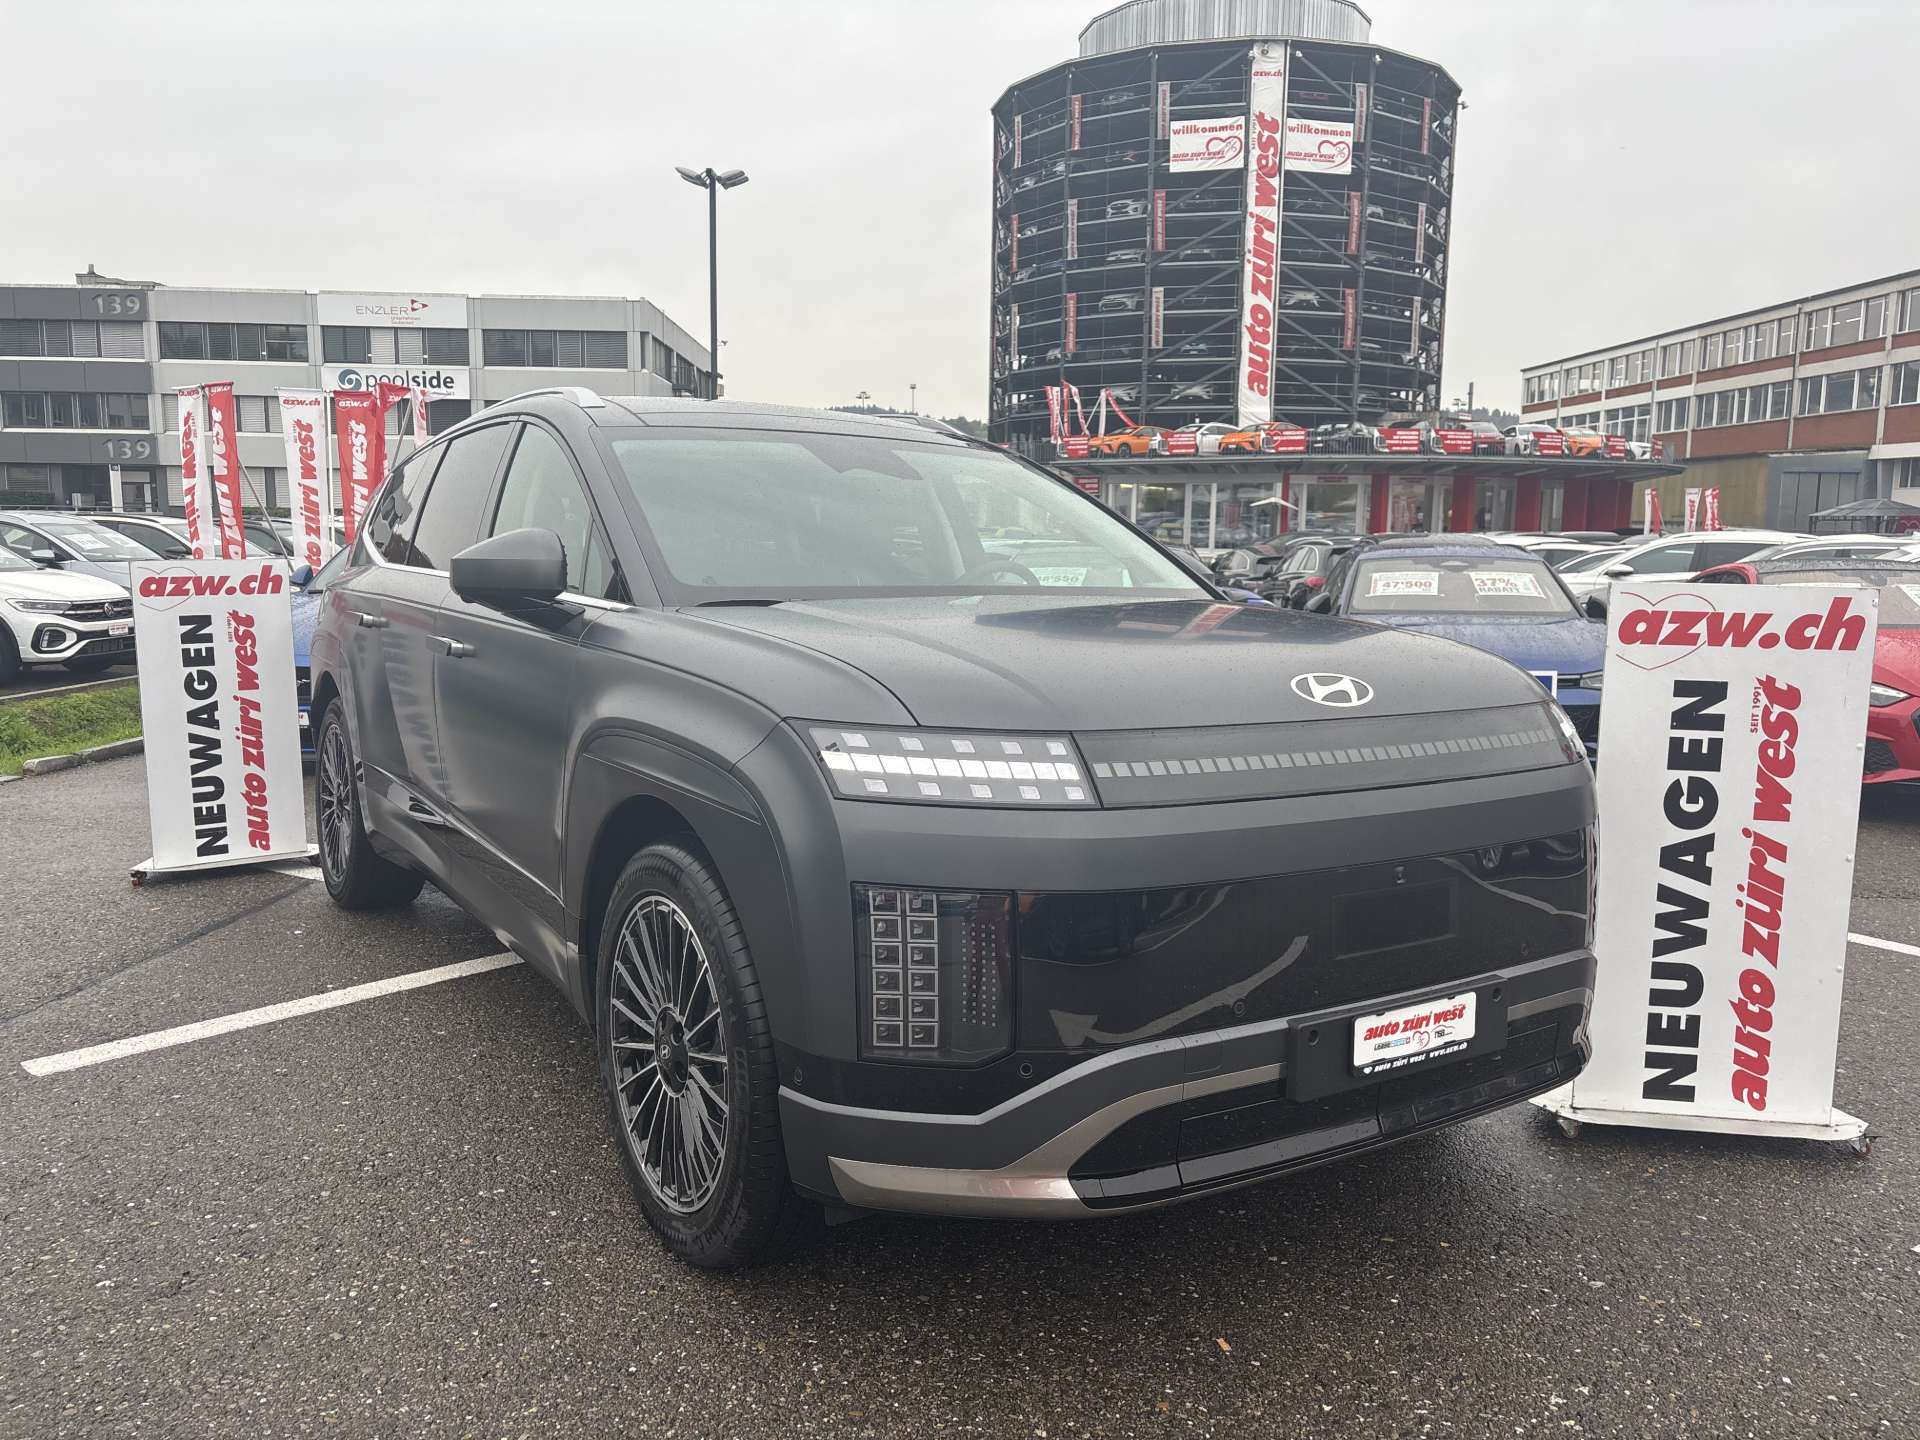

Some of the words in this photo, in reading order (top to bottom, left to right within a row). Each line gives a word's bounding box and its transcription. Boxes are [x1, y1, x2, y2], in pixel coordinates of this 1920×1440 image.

[1253, 69, 1283, 77] azw.ch
[1171, 123, 1244, 136] willkommen
[1287, 123, 1352, 137] willkommen
[1252, 110, 1281, 208] west
[1246, 211, 1277, 300] züri
[92, 293, 140, 315] 139
[355, 305, 409, 315] ENZLER
[1245, 304, 1272, 397] auto
[282, 396, 321, 408] azw.ch
[366, 370, 455, 391] poolside
[102, 439, 151, 459] 139
[293, 419, 318, 480] west
[346, 420, 368, 482] west
[297, 482, 321, 540] züri
[139, 565, 283, 598] azw.ch
[1474, 577, 1519, 587] 37%
[227, 609, 260, 692] west
[1617, 596, 1867, 651] azw.ch
[1749, 711, 1760, 734] SEIT
[1752, 686, 1762, 710] 1991
[178, 614, 230, 858] NEUWAGEN
[233, 695, 266, 772] züri
[1752, 673, 1804, 824] west
[240, 771, 271, 852] auto
[1641, 678, 1729, 1103] NEUWAGEN
[1735, 827, 1791, 970] züri
[1363, 1019, 1401, 1041] auto
[1401, 1011, 1432, 1033] züri
[1433, 1004, 1467, 1025] west
[1728, 968, 1777, 1112] auto
